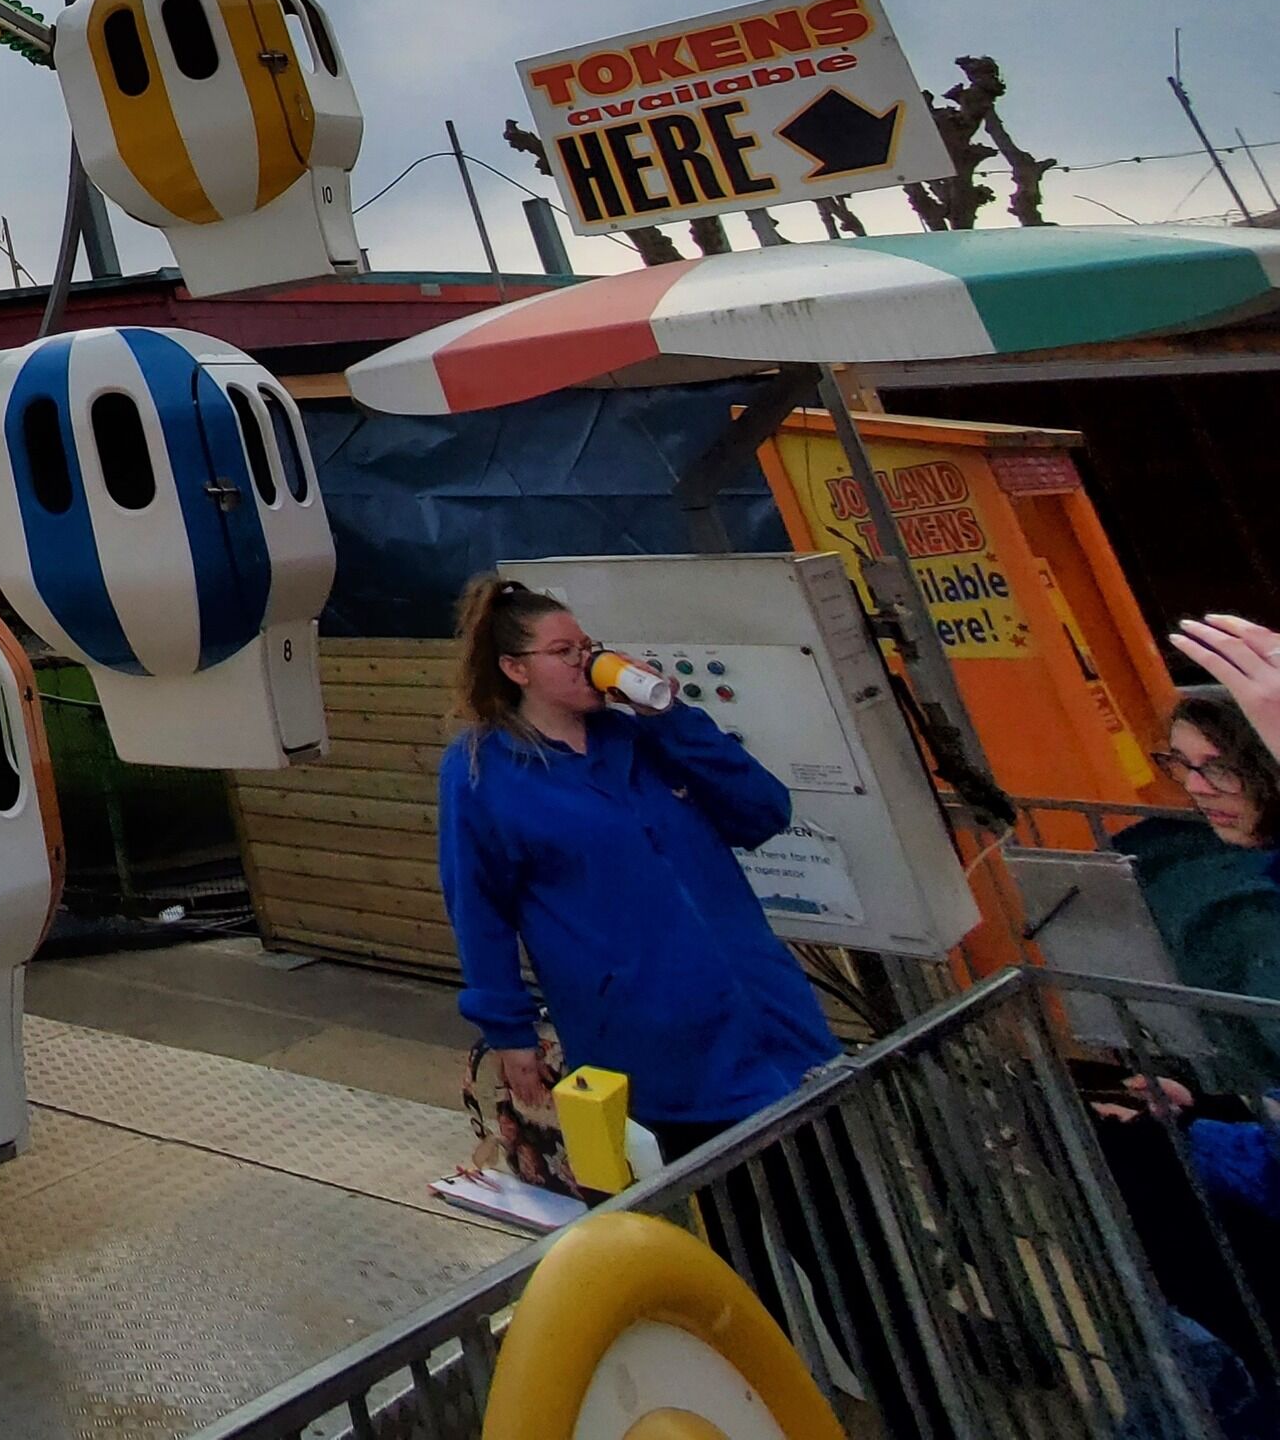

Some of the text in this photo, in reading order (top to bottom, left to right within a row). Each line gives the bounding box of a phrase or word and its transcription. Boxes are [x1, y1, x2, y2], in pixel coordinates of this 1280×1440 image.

[567, 52, 858, 127] available
[557, 101, 776, 222] HERE
[321, 186, 333, 205] 10
[826, 461, 968, 520] JOLAND
[856, 508, 985, 559] TKENS
[284, 639, 292, 662] 8
[937, 608, 1000, 646] ere!
